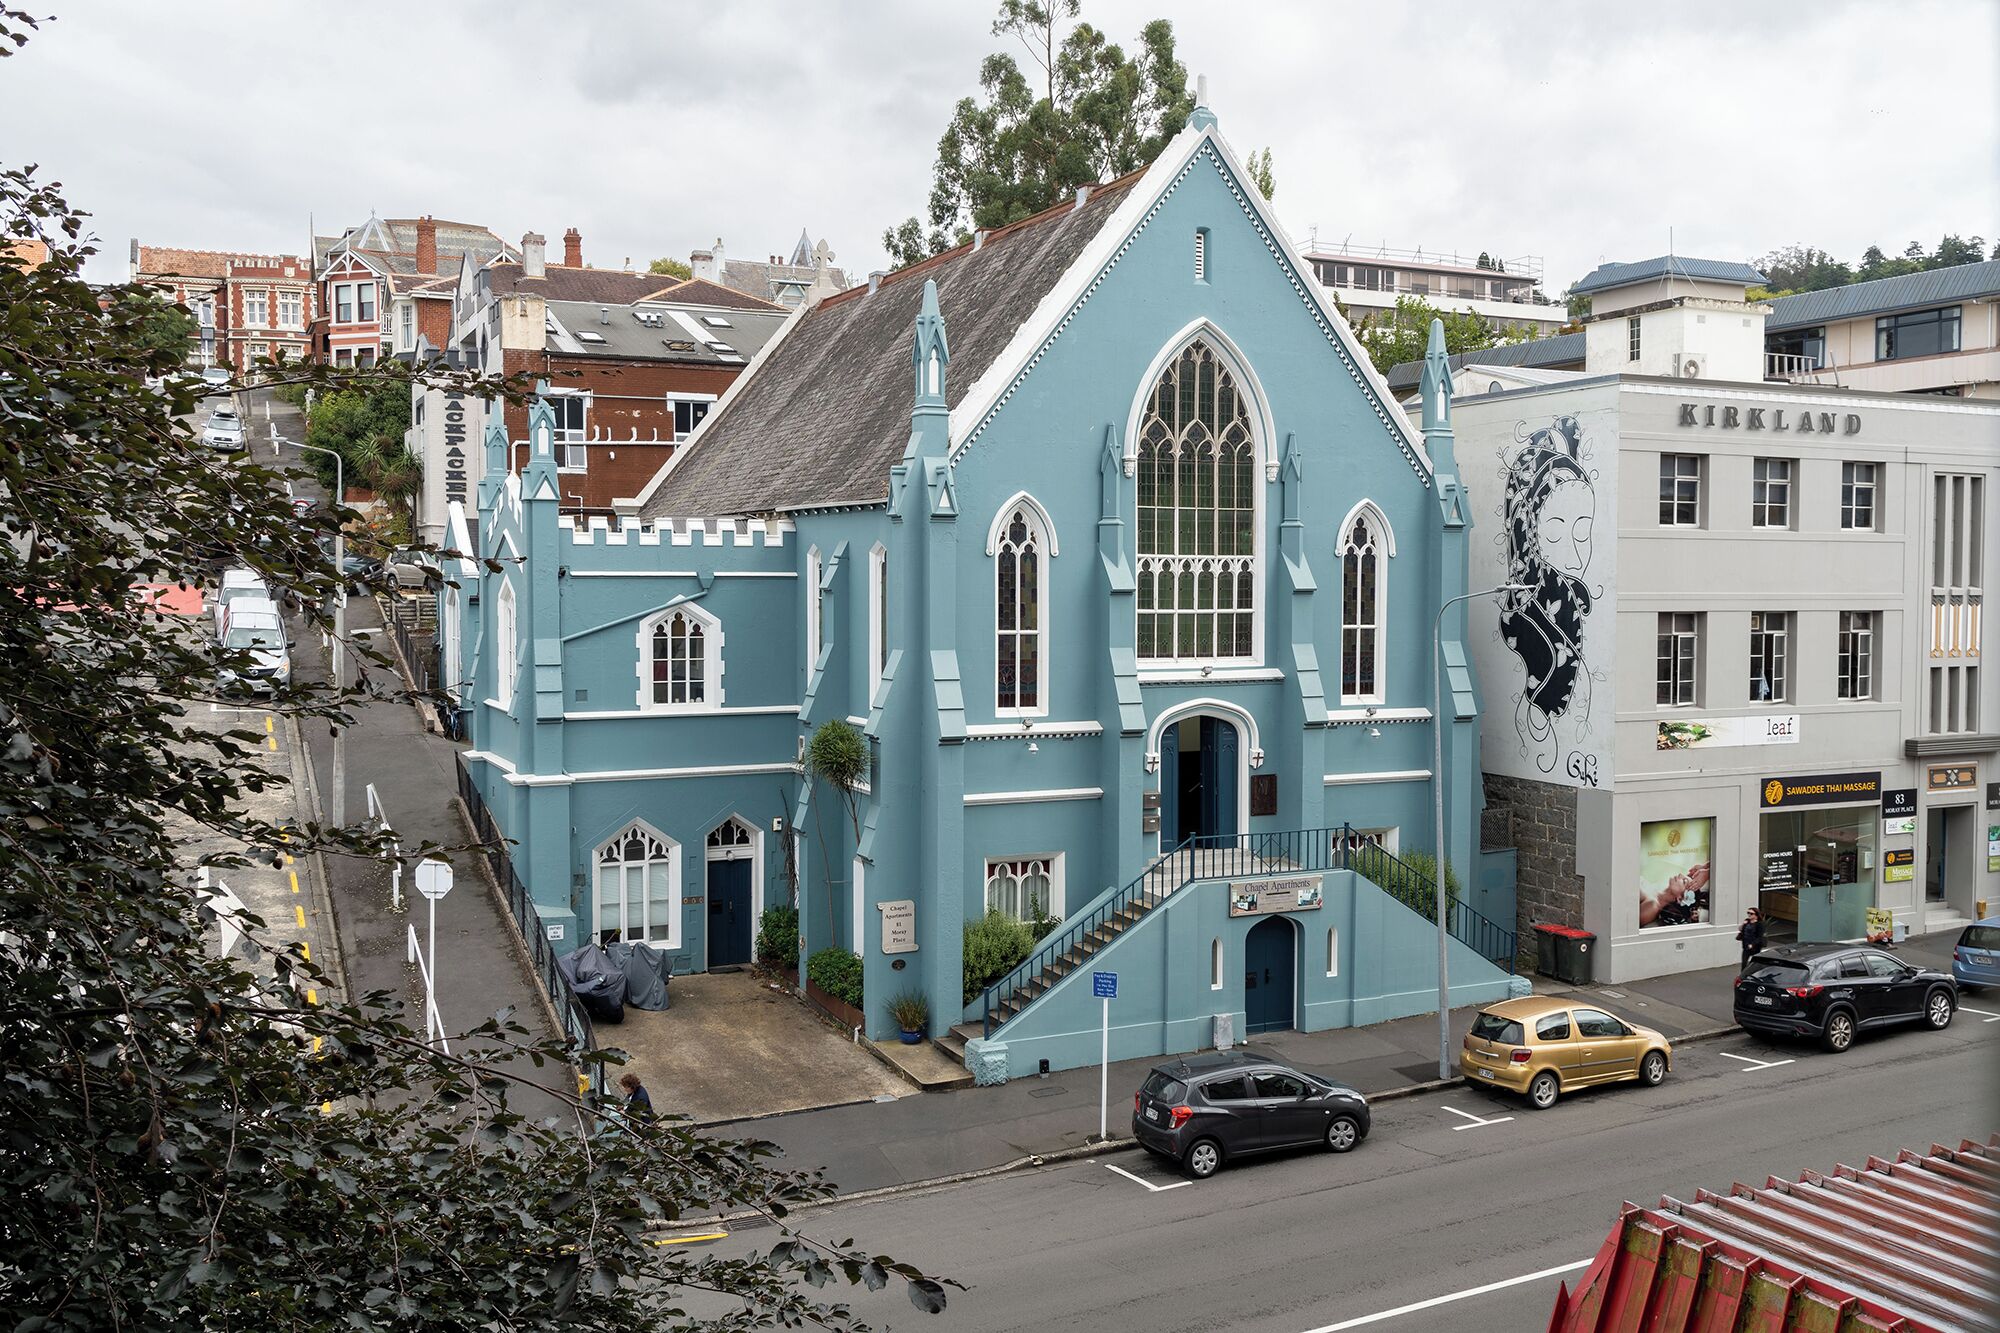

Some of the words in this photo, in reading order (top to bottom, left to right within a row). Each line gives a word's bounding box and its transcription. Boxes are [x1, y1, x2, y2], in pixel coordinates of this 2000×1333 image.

[1680, 403, 1862, 434] KIRKLAND
[445, 391, 467, 513] BACKPACKER
[1767, 717, 1793, 735] leaf
[1786, 784, 1825, 796] SAWADDEE
[1826, 783, 1842, 793] THAI
[1843, 781, 1876, 792] MASSAGE
[1895, 793, 1905, 804] 83
[1244, 882, 1269, 893] Chapel
[1271, 880, 1311, 892] Apartments
